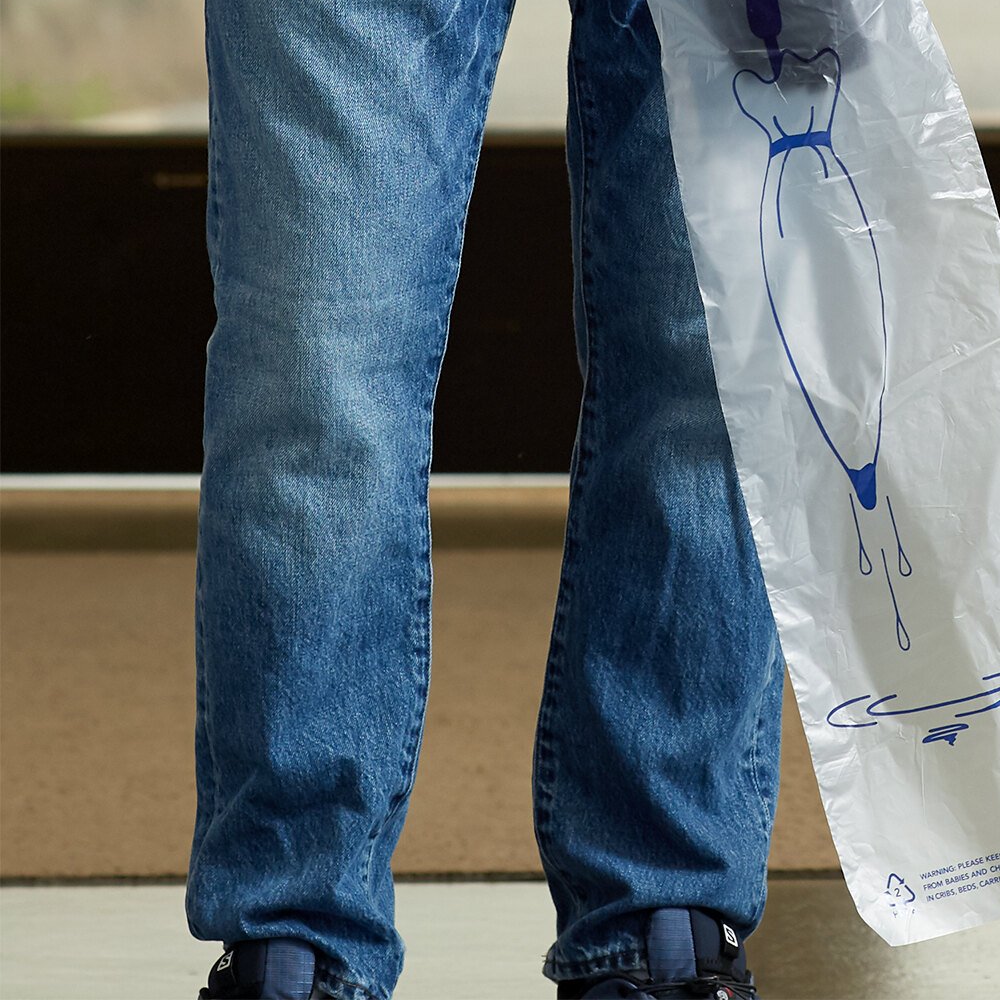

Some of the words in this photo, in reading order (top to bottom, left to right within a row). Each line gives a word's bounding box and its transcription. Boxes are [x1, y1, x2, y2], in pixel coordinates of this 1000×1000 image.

[920, 865, 957, 880] WARNING:
[957, 856, 985, 870] PLEASE
[923, 880, 943, 891] FROM
[945, 873, 970, 886] BABIES
[971, 868, 988, 879] AND
[894, 887, 902, 898] 2
[926, 894, 935, 902] IN
[935, 889, 958, 900] CRIBS,
[958, 883, 979, 894] BEDS,
